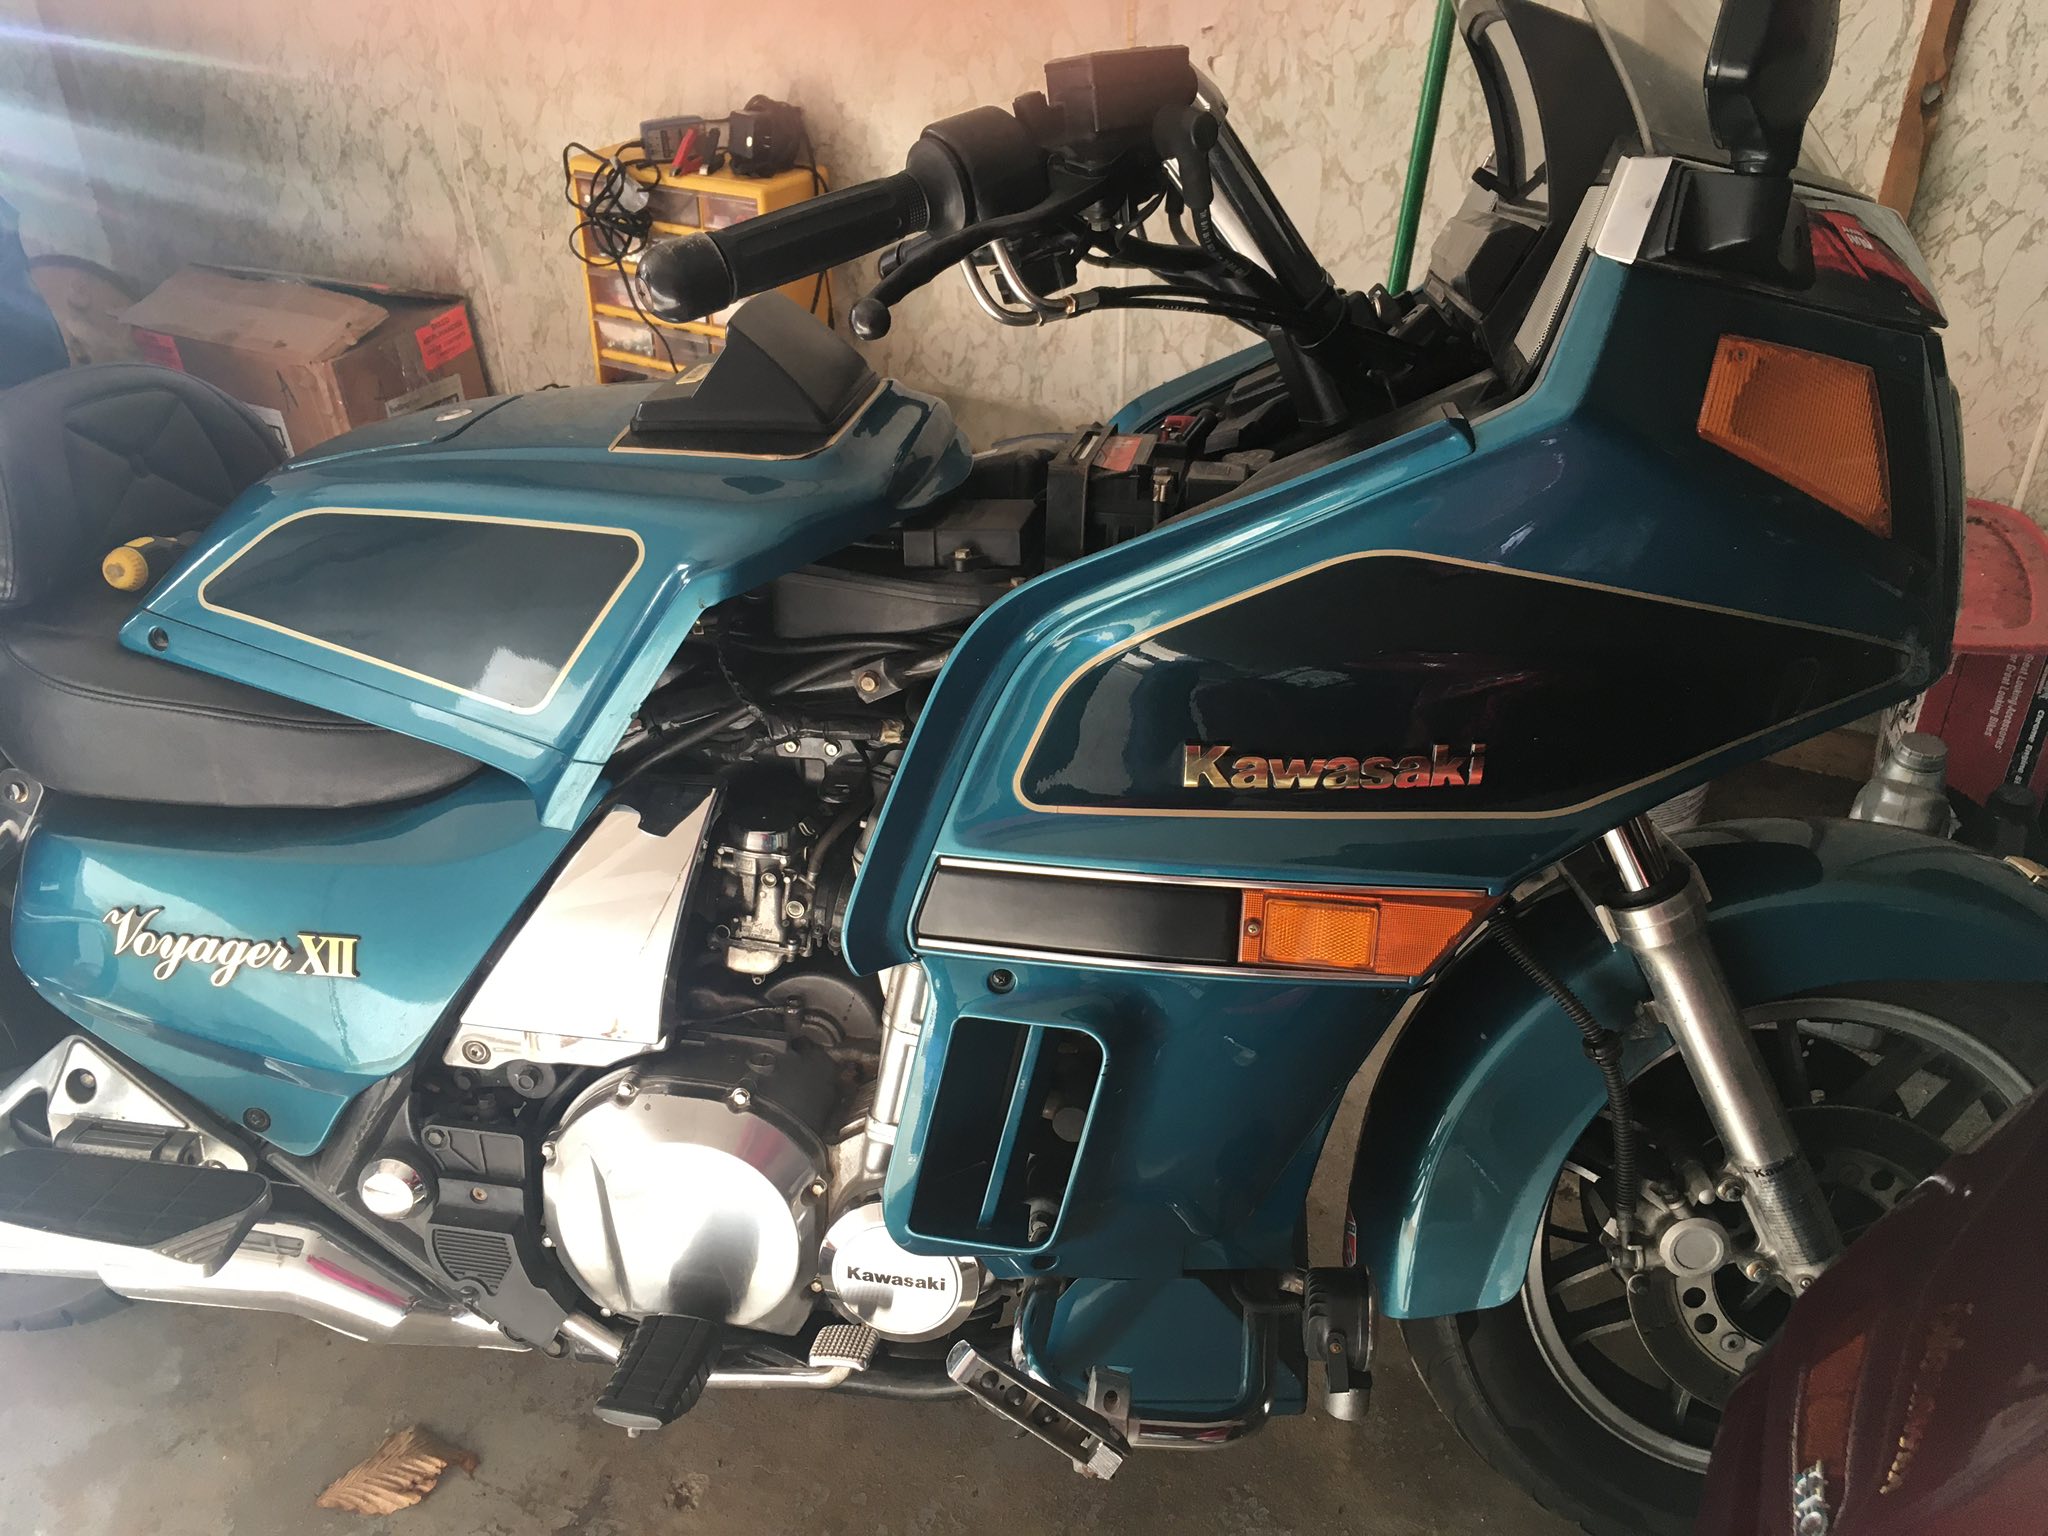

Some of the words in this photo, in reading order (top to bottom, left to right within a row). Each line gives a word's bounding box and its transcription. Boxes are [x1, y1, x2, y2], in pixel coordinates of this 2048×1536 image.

[2001, 664, 2017, 685] Great
[1989, 685, 2010, 715] Looking
[2007, 675, 2027, 705] Looking
[1984, 716, 2000, 737] Bikes
[2028, 709, 2045, 743] Chrome
[1182, 743, 1487, 788] Kawasaki
[2017, 744, 2033, 774] Engine
[102, 905, 294, 987] Voyager
[295, 931, 361, 978] XII
[847, 1266, 946, 1291] Kawasaki
